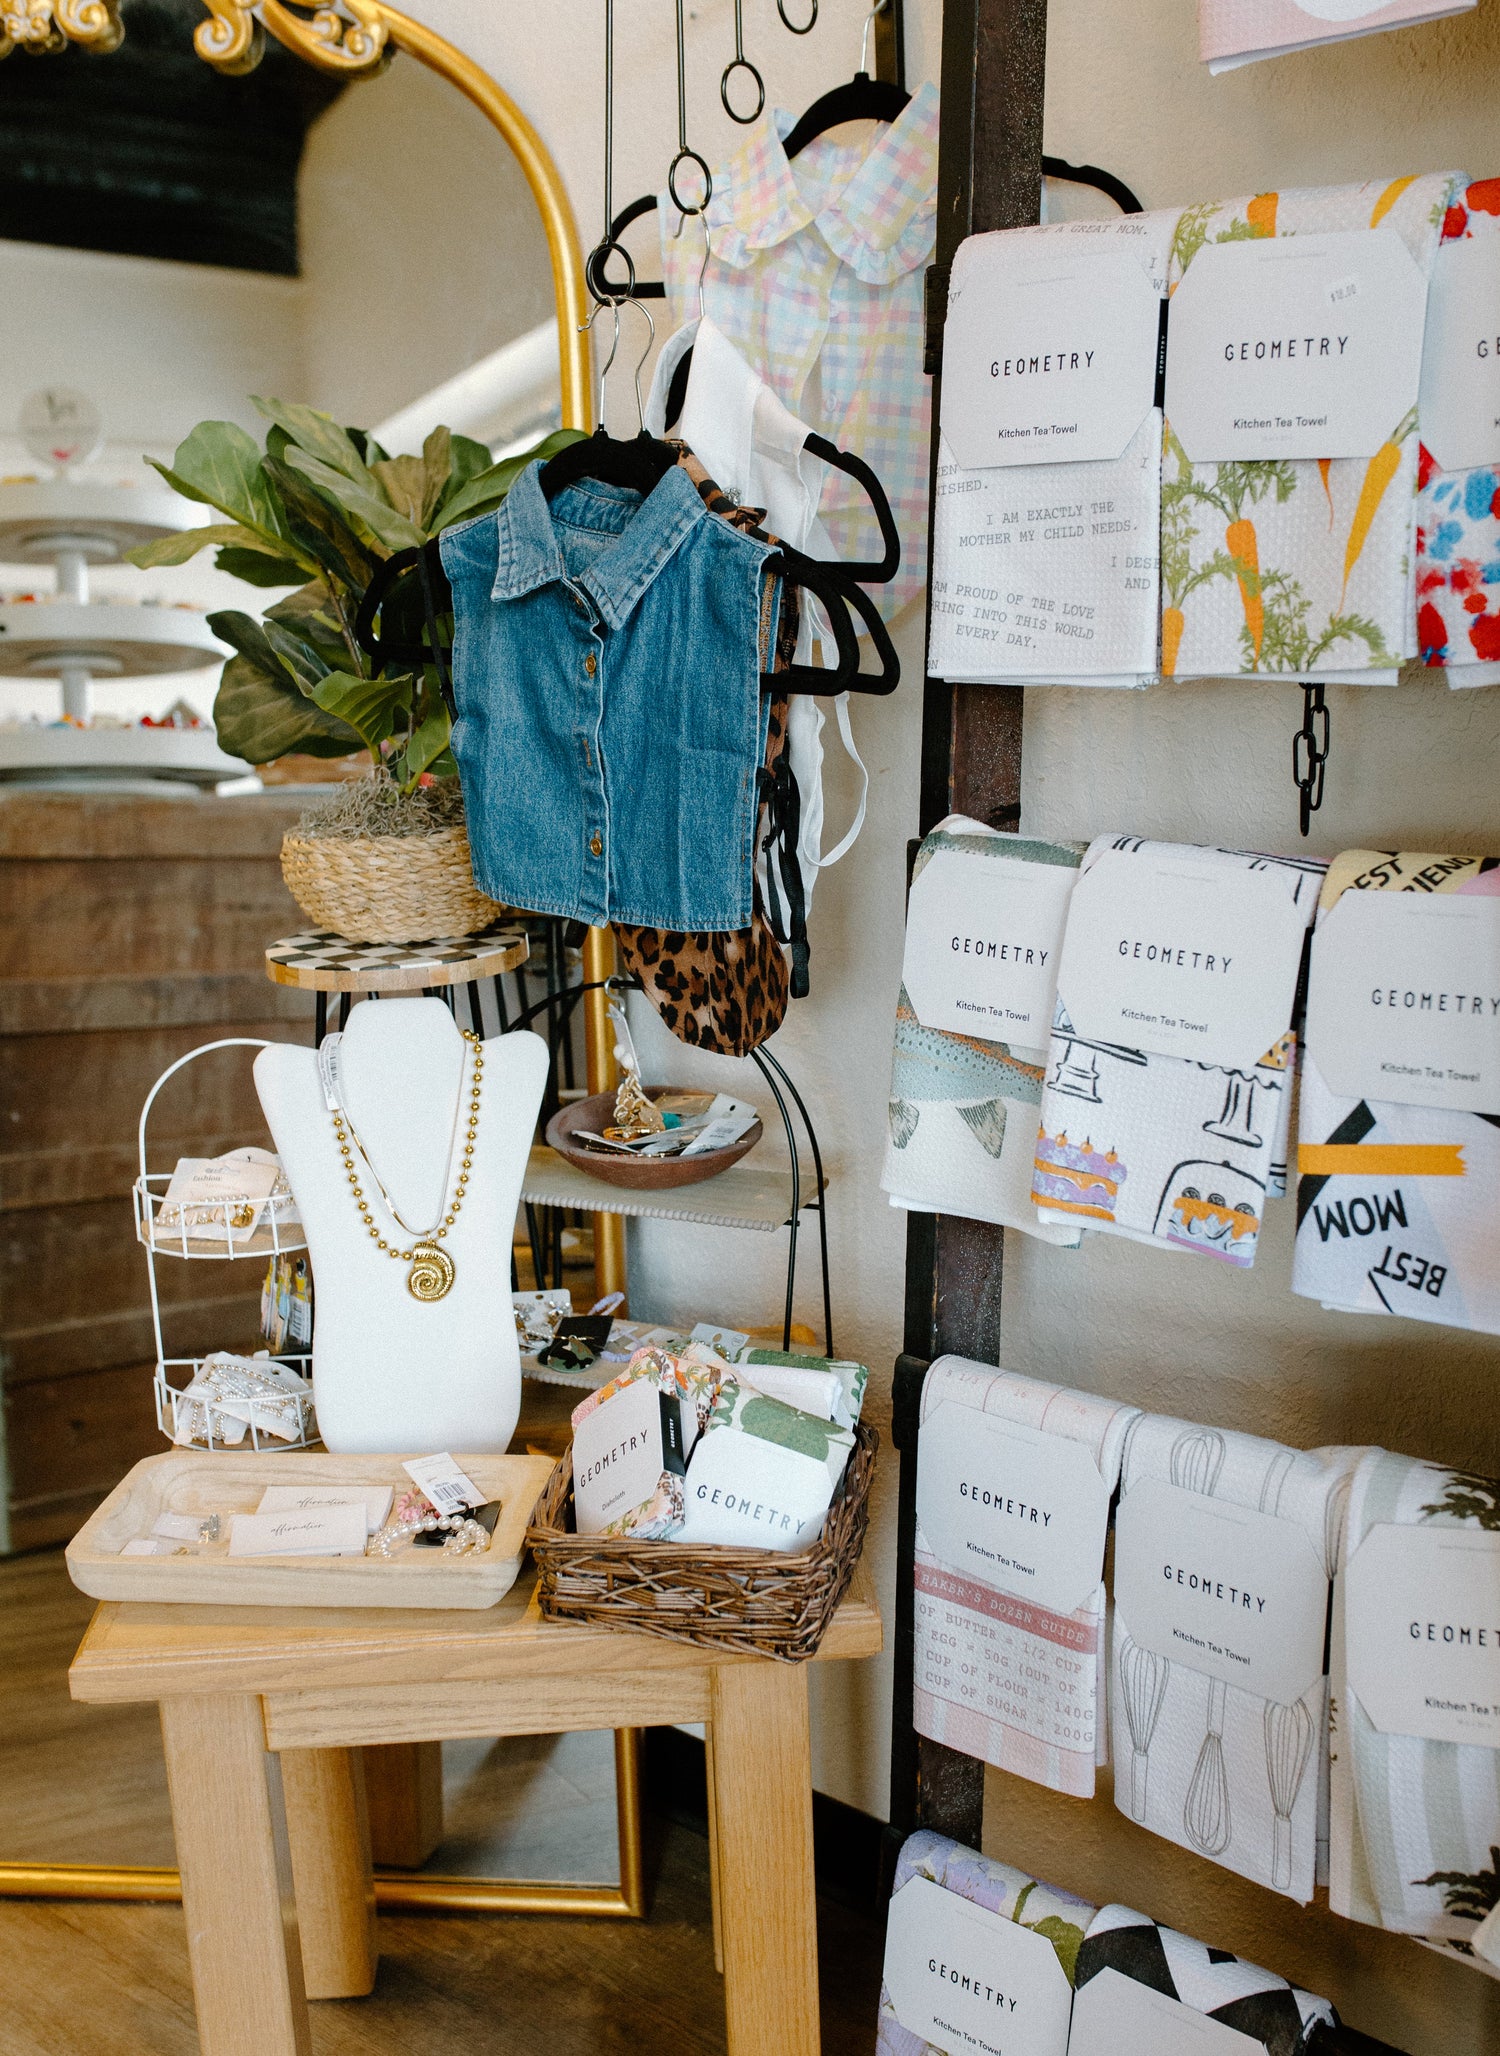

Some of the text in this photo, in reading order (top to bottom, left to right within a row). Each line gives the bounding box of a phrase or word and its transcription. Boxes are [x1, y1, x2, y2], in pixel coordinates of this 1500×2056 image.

[1071, 225, 1111, 233] GREAT
[1116, 225, 1148, 235] MOM.
[990, 351, 1095, 378] GEOMETRY
[1224, 336, 1349, 361] GEOMETRY
[998, 424, 1078, 439] Kitchen Tea Towel
[1234, 415, 1327, 430] Kitchen Tea Towel
[986, 501, 1115, 525] I AM EXACTLY THE
[959, 520, 1138, 547] MOTHER MY CHILD NEEDS.
[1111, 556, 1118, 568] I
[1124, 578, 1151, 590] AND
[955, 584, 998, 602] PROUD
[1006, 593, 1024, 606] OF
[1032, 597, 1056, 612] THE
[1062, 603, 1095, 620] LOVE
[955, 624, 1037, 649] EVERY DAY.
[974, 607, 1007, 623] INTO
[1015, 614, 1047, 631] THIS
[1055, 622, 1094, 640] WORLD
[1341, 857, 1403, 895] EST
[1402, 856, 1477, 893] IEND
[951, 936, 1049, 967] GEOMETRY
[1118, 940, 1233, 974] GEOMETRY
[956, 999, 1030, 1022] Kitchen Tea Towel
[1371, 989, 1500, 1016] GEOMETRY
[1121, 1007, 1209, 1033] Kitchen Tea Towel
[1380, 1062, 1480, 1083] Kitchen Tea Towel
[1313, 1189, 1409, 1242] MOM
[1373, 1246, 1447, 1297] BEST
[580, 1429, 648, 1488] GEOMETRY
[696, 1484, 807, 1536] GEOMETRY
[960, 1482, 1053, 1528] GEOMETRY
[966, 1541, 995, 1561] Kitchen
[997, 1553, 1010, 1567] Tea
[1012, 1560, 1036, 1576] Towel
[1163, 1564, 1267, 1614] GEOMETRY
[921, 1573, 1086, 1643] BAKER'S DOZEN GUIDE
[919, 1603, 936, 1618] OF
[945, 1614, 998, 1641] BUTTER
[1023, 1642, 1046, 1662] 1/2
[1055, 1656, 1083, 1675] CUP
[1173, 1628, 1205, 1648] Kitchen
[1207, 1638, 1223, 1654] Tea
[1224, 1644, 1251, 1666] Towel
[931, 1629, 957, 1648] EGG
[984, 1649, 1009, 1667] 50G
[1018, 1661, 1050, 1685] (OUT
[1058, 1680, 1078, 1695] OF
[926, 1650, 951, 1667] CUP
[961, 1663, 978, 1677] OF
[988, 1672, 1028, 1698] FLOUR
[1055, 1701, 1094, 1720] 140G
[926, 1671, 950, 1689] CUP
[960, 1684, 977, 1698] OF
[986, 1694, 1028, 1721] SUGAR
[1054, 1723, 1093, 1742] 200G
[1424, 1696, 1467, 1713] Kitchen
[1470, 1702, 1490, 1716] Tea
[928, 1959, 1018, 2013] GEOMETRY
[933, 2015, 962, 2038] Kitchen
[963, 2030, 977, 2046] Tea
[979, 2038, 1002, 2056] Towel
